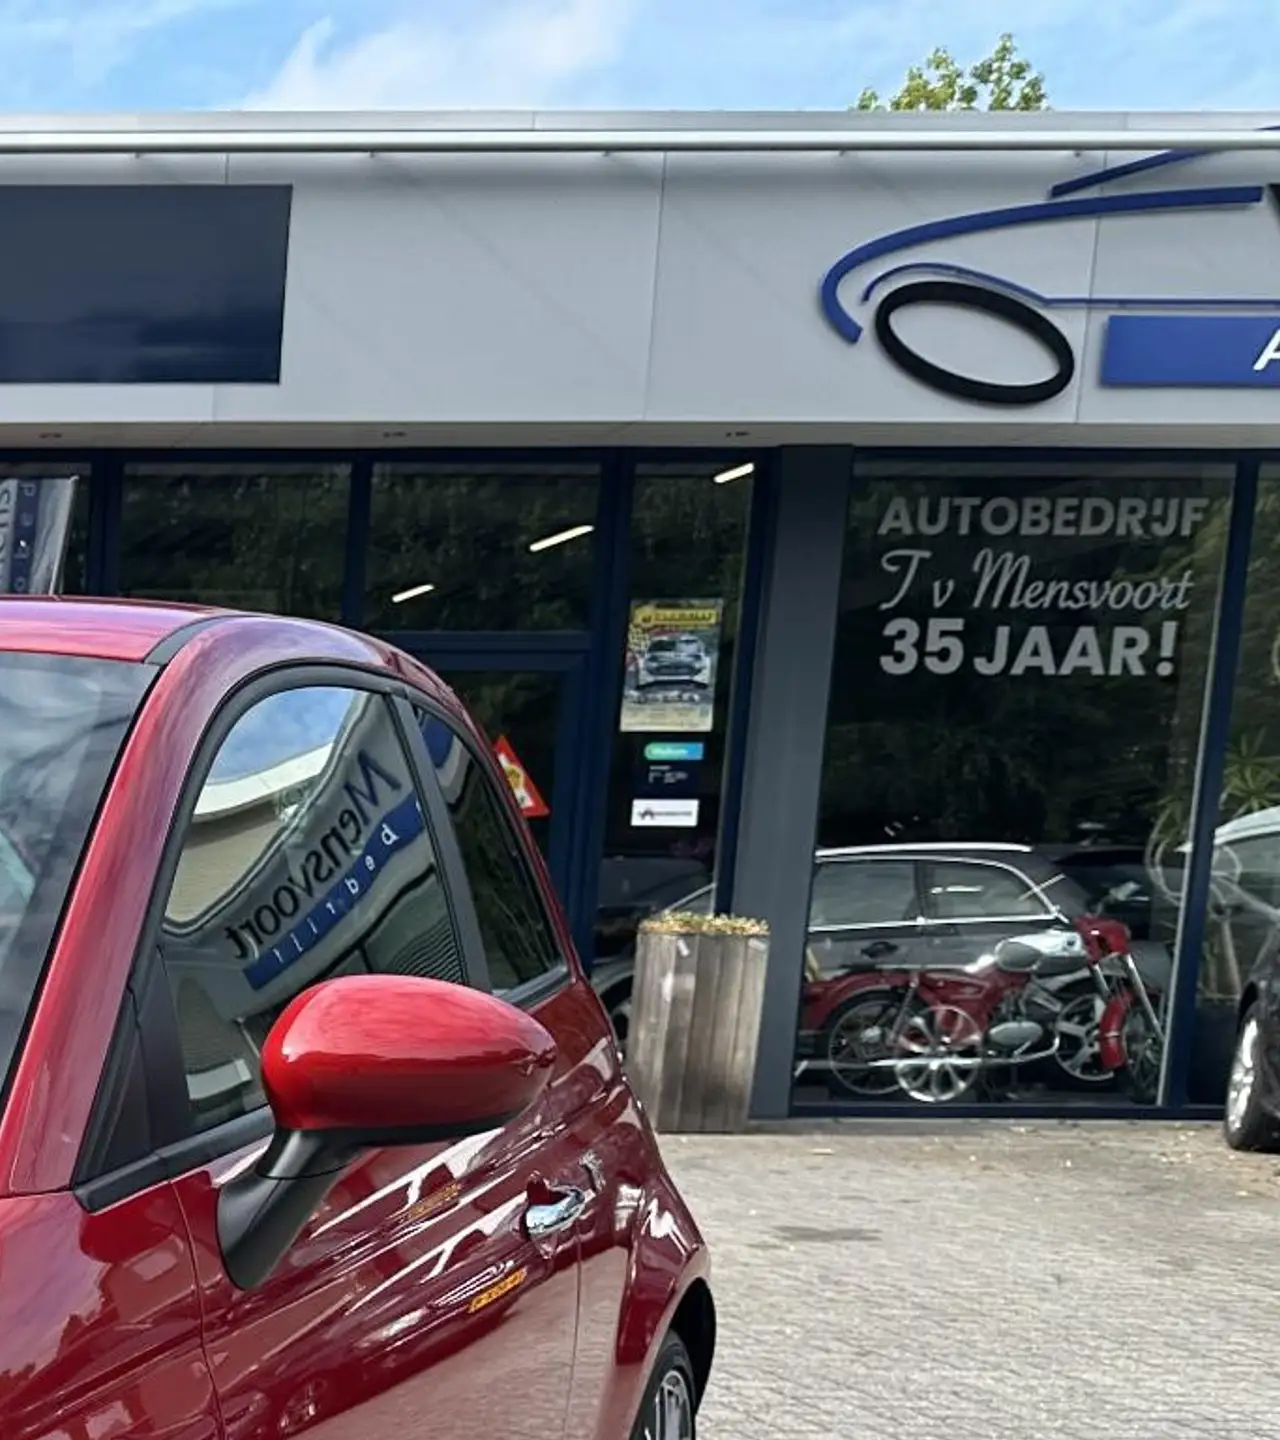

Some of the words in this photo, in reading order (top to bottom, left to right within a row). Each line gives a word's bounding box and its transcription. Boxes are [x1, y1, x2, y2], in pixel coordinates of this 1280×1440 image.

[877, 496, 1209, 537] AUTOBEDRIJF
[878, 548, 932, 610] T
[933, 577, 955, 609] v
[971, 548, 1196, 611] Mensvoort
[879, 617, 966, 677] 35
[973, 620, 1179, 677] JAAR!
